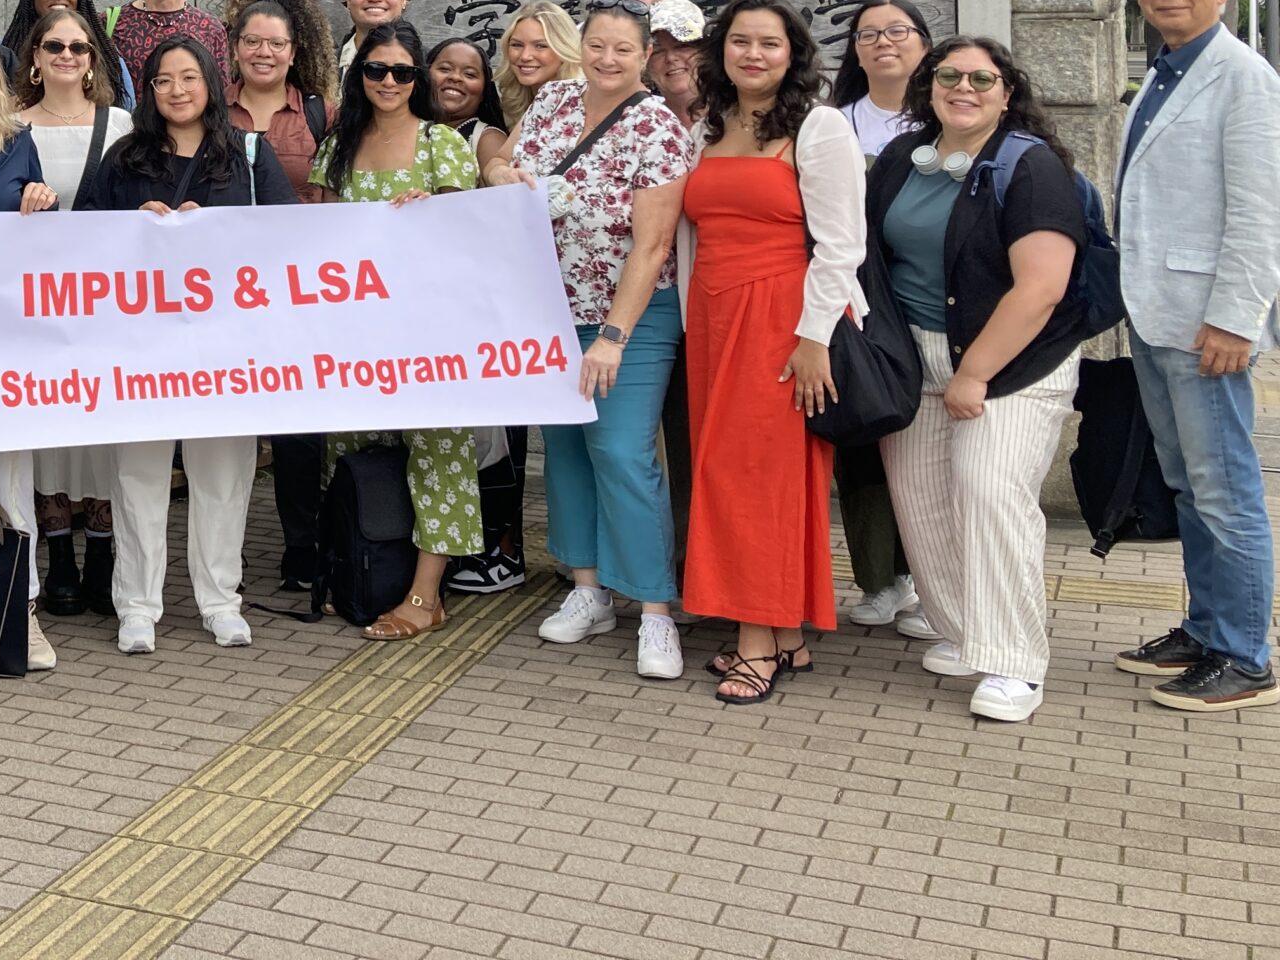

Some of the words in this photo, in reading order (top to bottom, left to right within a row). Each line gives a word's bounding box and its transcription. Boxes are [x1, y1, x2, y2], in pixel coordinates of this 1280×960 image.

[22, 267, 214, 318] IMPULS
[233, 265, 271, 310] &
[286, 258, 390, 306] LSA
[0, 367, 101, 413] Study
[112, 353, 304, 401] Immersion
[313, 351, 468, 396] Program
[476, 335, 569, 379] 2024
